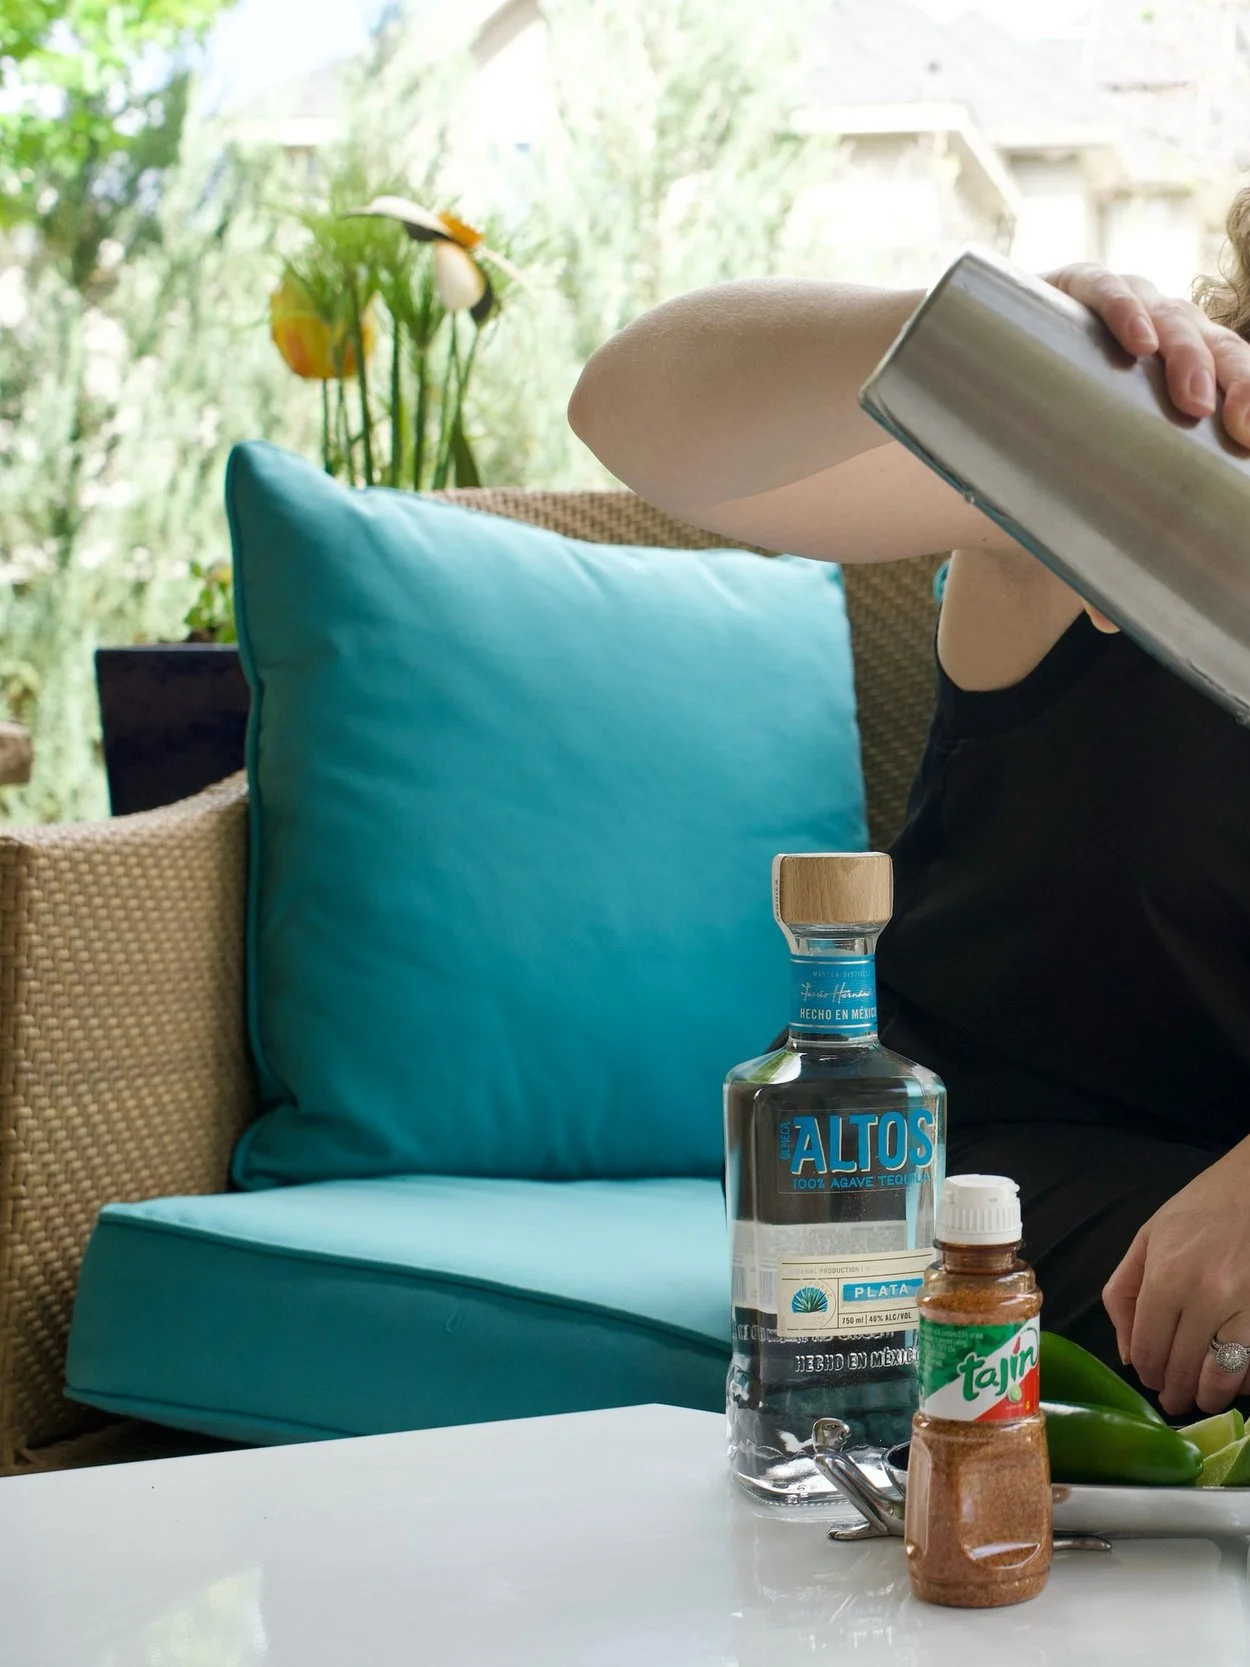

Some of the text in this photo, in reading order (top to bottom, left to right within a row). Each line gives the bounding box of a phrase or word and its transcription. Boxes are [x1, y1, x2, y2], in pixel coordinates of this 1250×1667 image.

[800, 1008, 831, 1020] HECHO
[835, 1009, 848, 1020] EN
[790, 1109, 935, 1174] ALTOS
[792, 1172, 930, 1190] 100% AGAVE TEQUILA
[819, 1265, 860, 1275] PRODUCTION
[854, 1284, 908, 1298] PLATA
[842, 1311, 913, 1325] 750 ml 40% ALC/VOL
[796, 1355, 844, 1373] HECHO
[848, 1352, 867, 1370] EN
